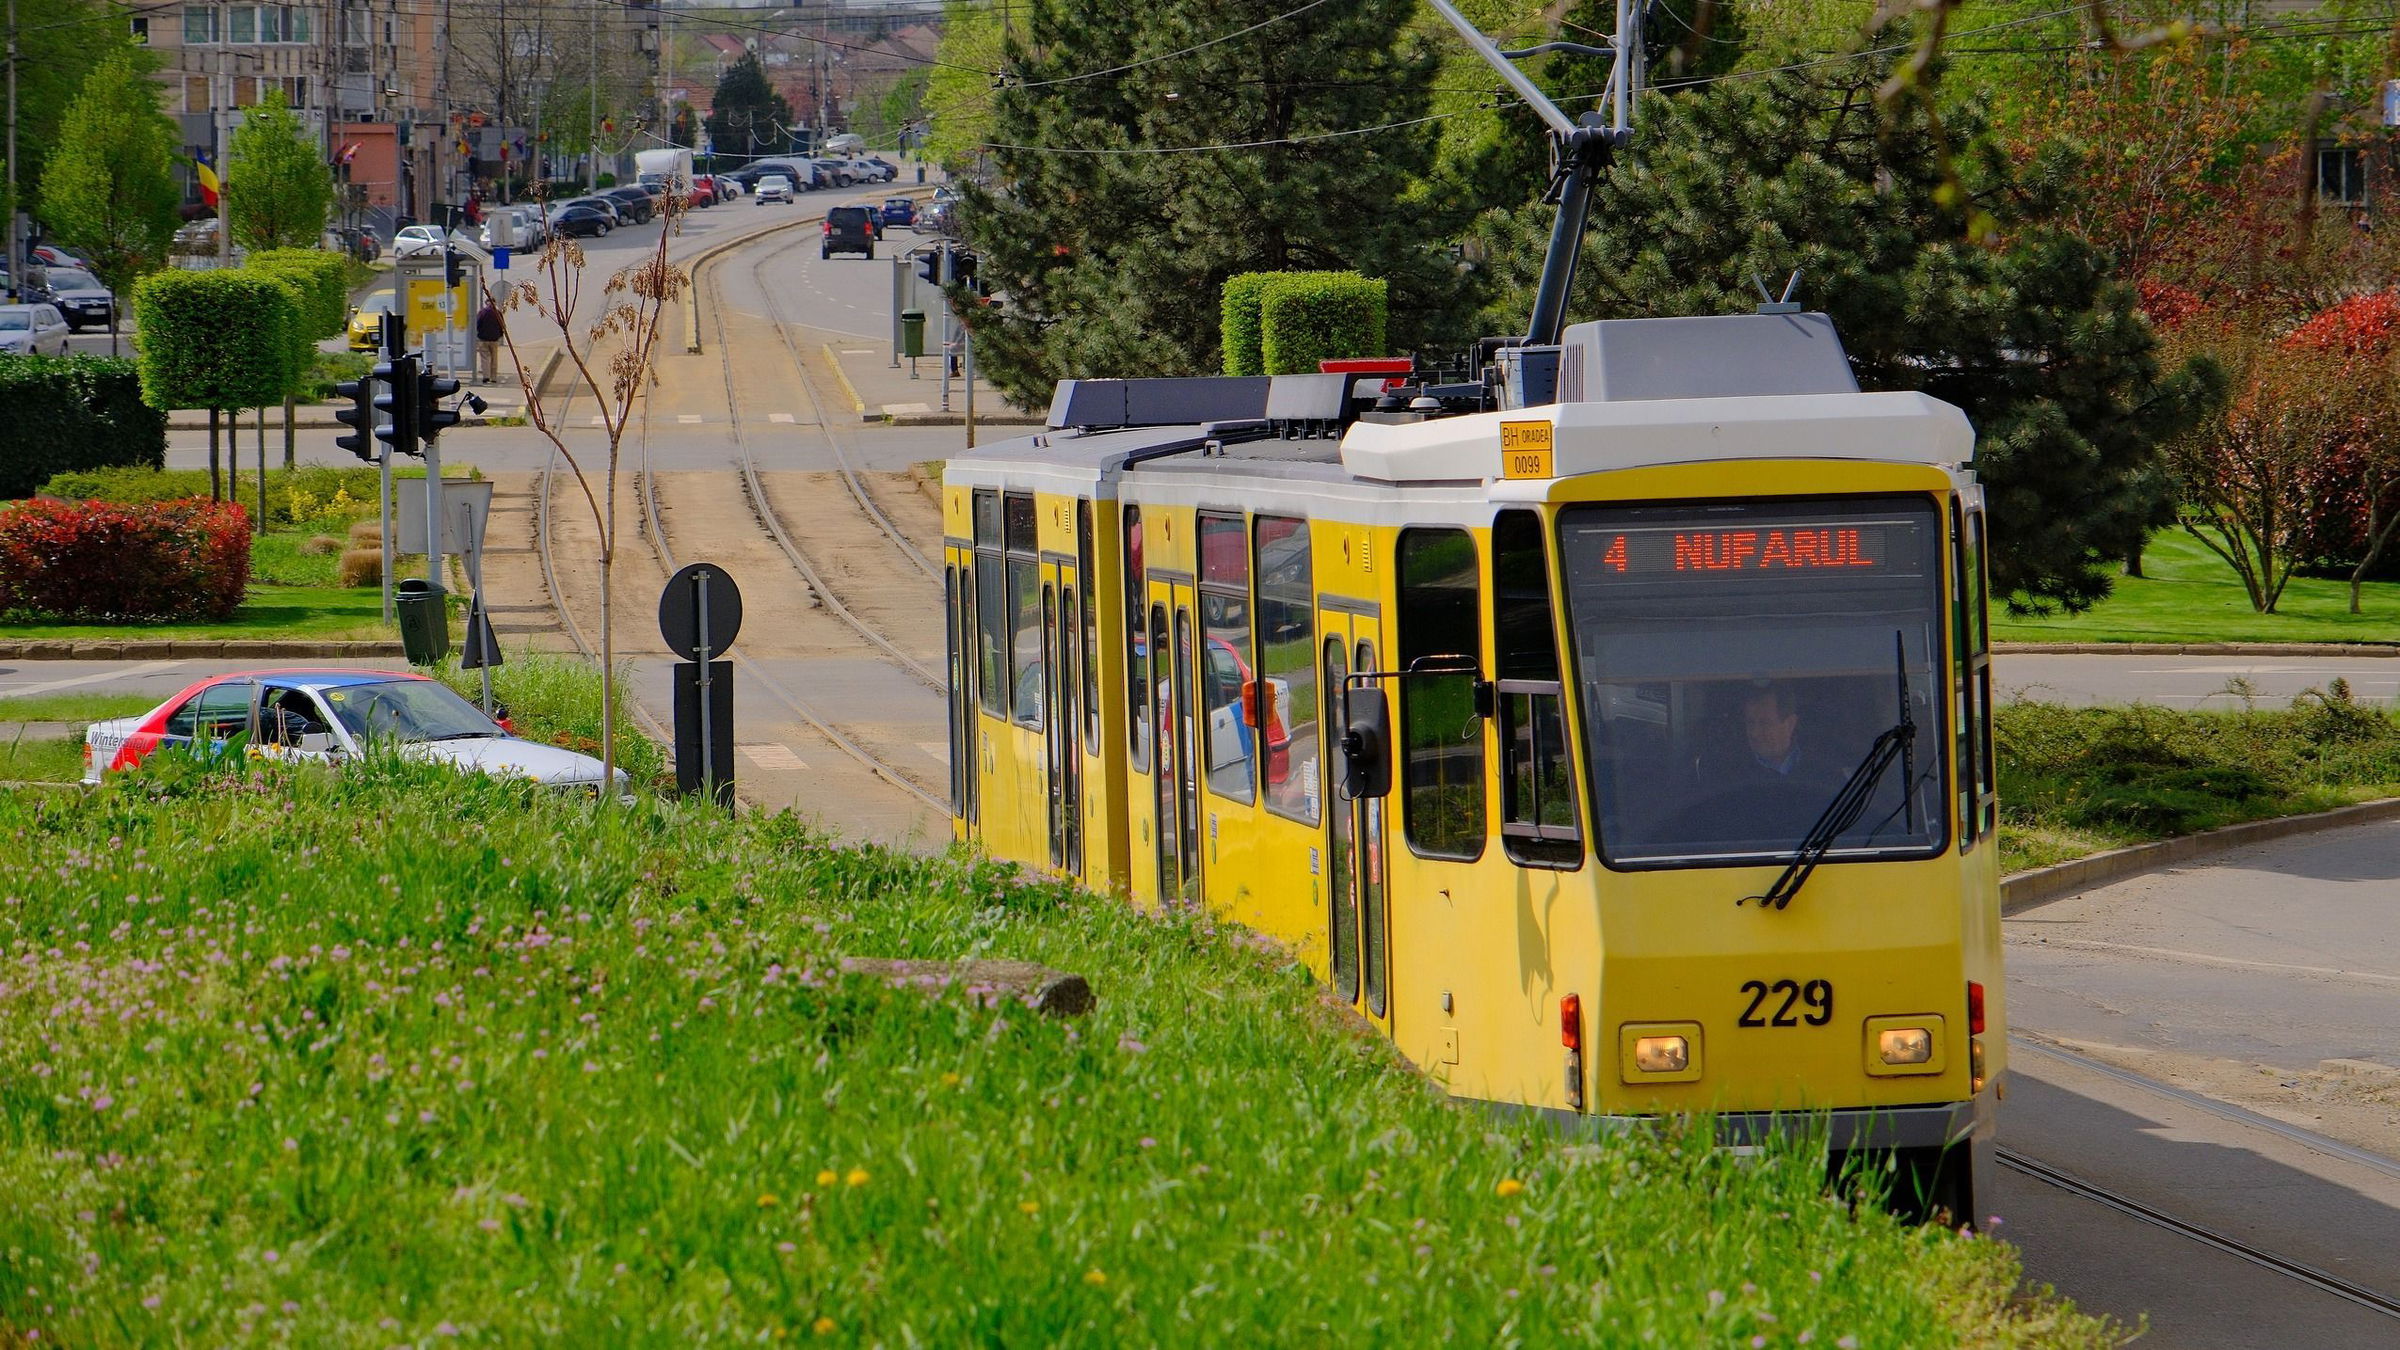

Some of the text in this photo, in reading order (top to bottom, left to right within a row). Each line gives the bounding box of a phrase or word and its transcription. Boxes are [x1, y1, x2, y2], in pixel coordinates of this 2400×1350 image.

[1503, 427, 1549, 446] BH ORADEA
[1514, 455, 1540, 473] 0099
[1604, 530, 1873, 571] 4 NUFARUL
[1738, 979, 1833, 1027] 229
